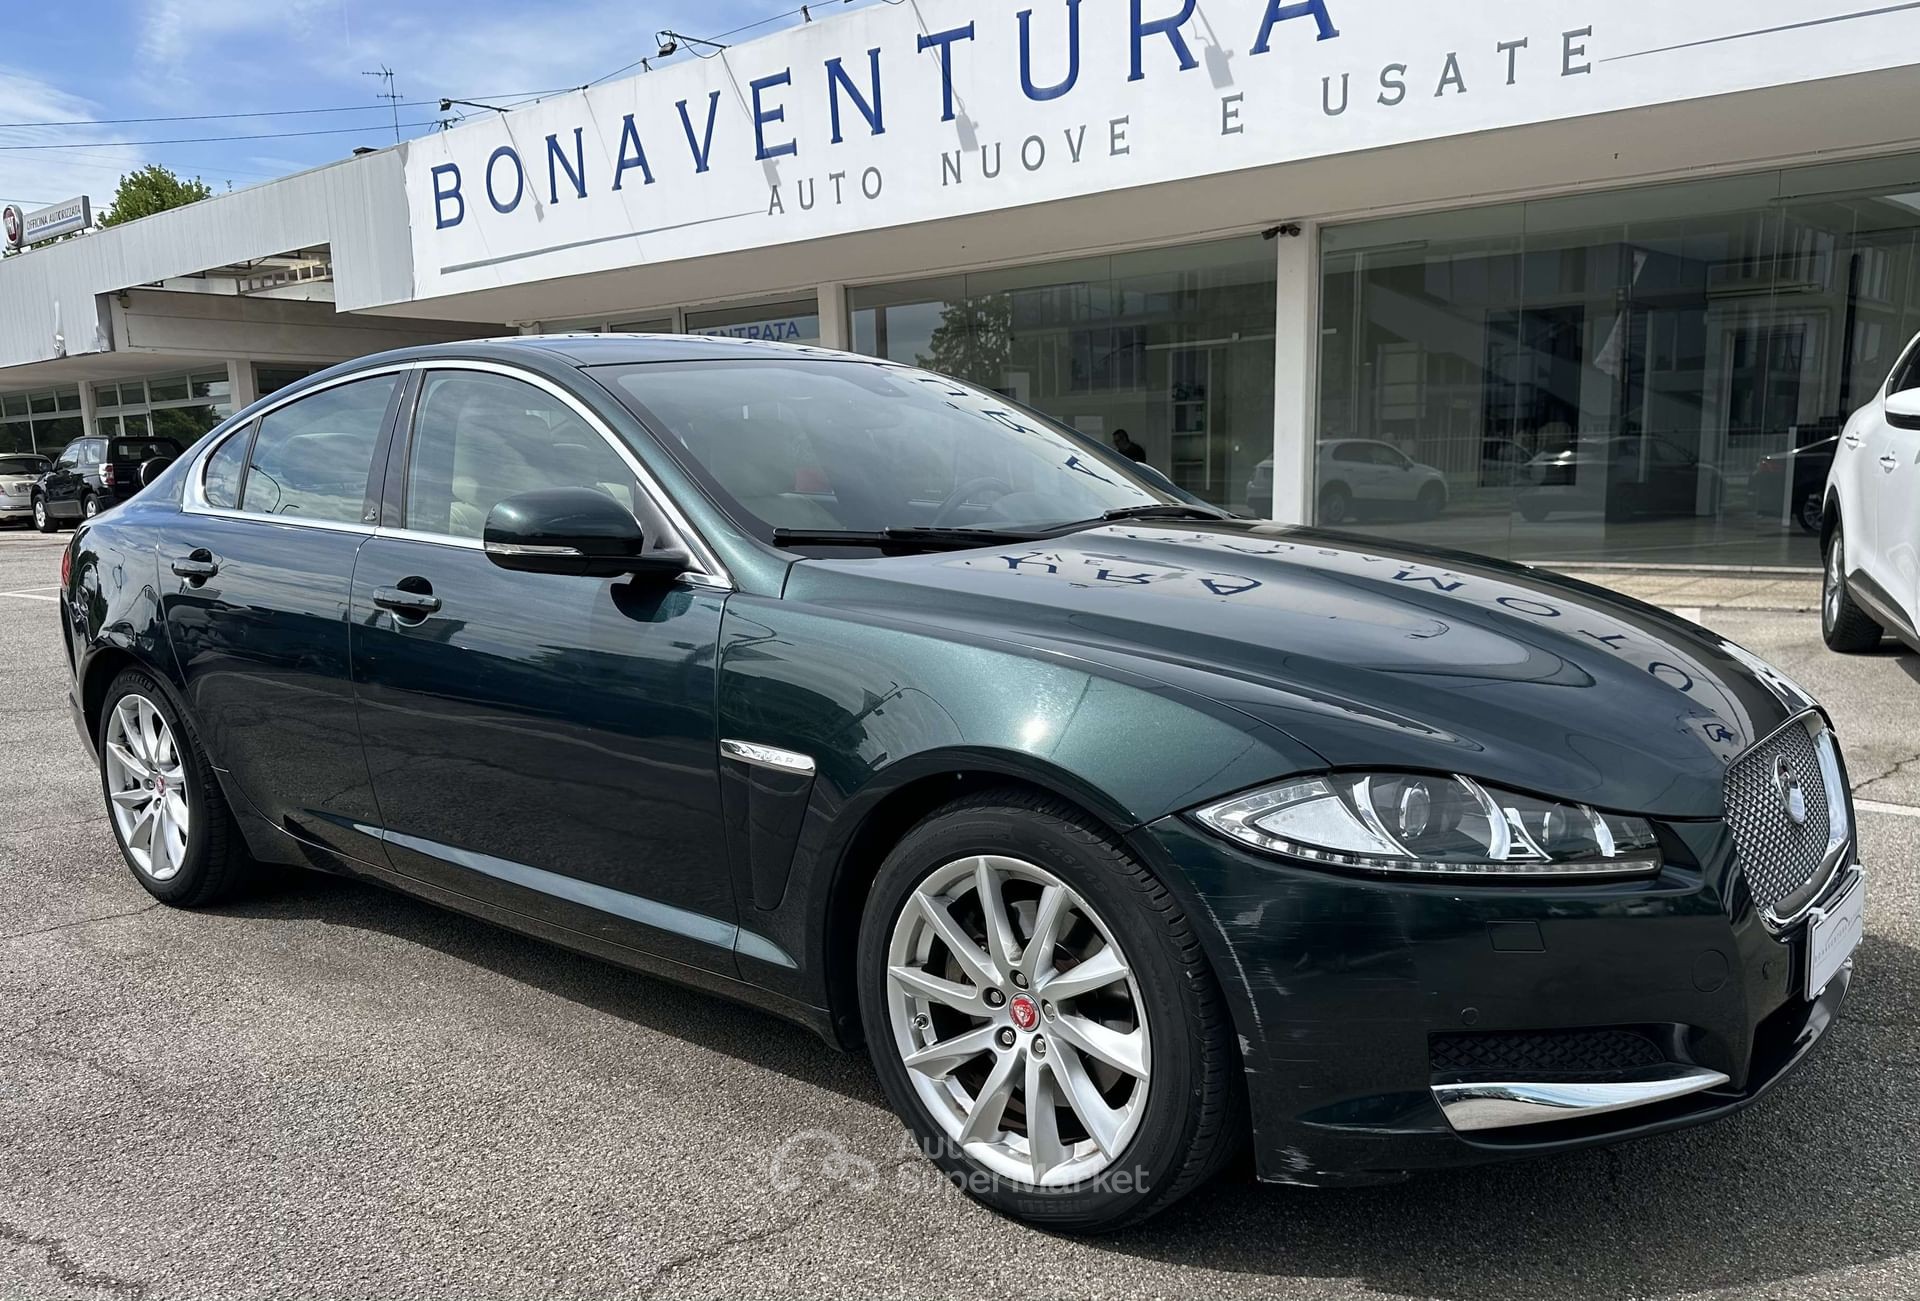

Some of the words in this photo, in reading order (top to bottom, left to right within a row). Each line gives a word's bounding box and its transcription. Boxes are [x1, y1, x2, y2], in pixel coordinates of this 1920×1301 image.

[768, 166, 882, 215] AUTO
[941, 115, 1129, 186] NUOVE
[1220, 92, 1244, 135] E
[1321, 25, 1593, 116] USATE
